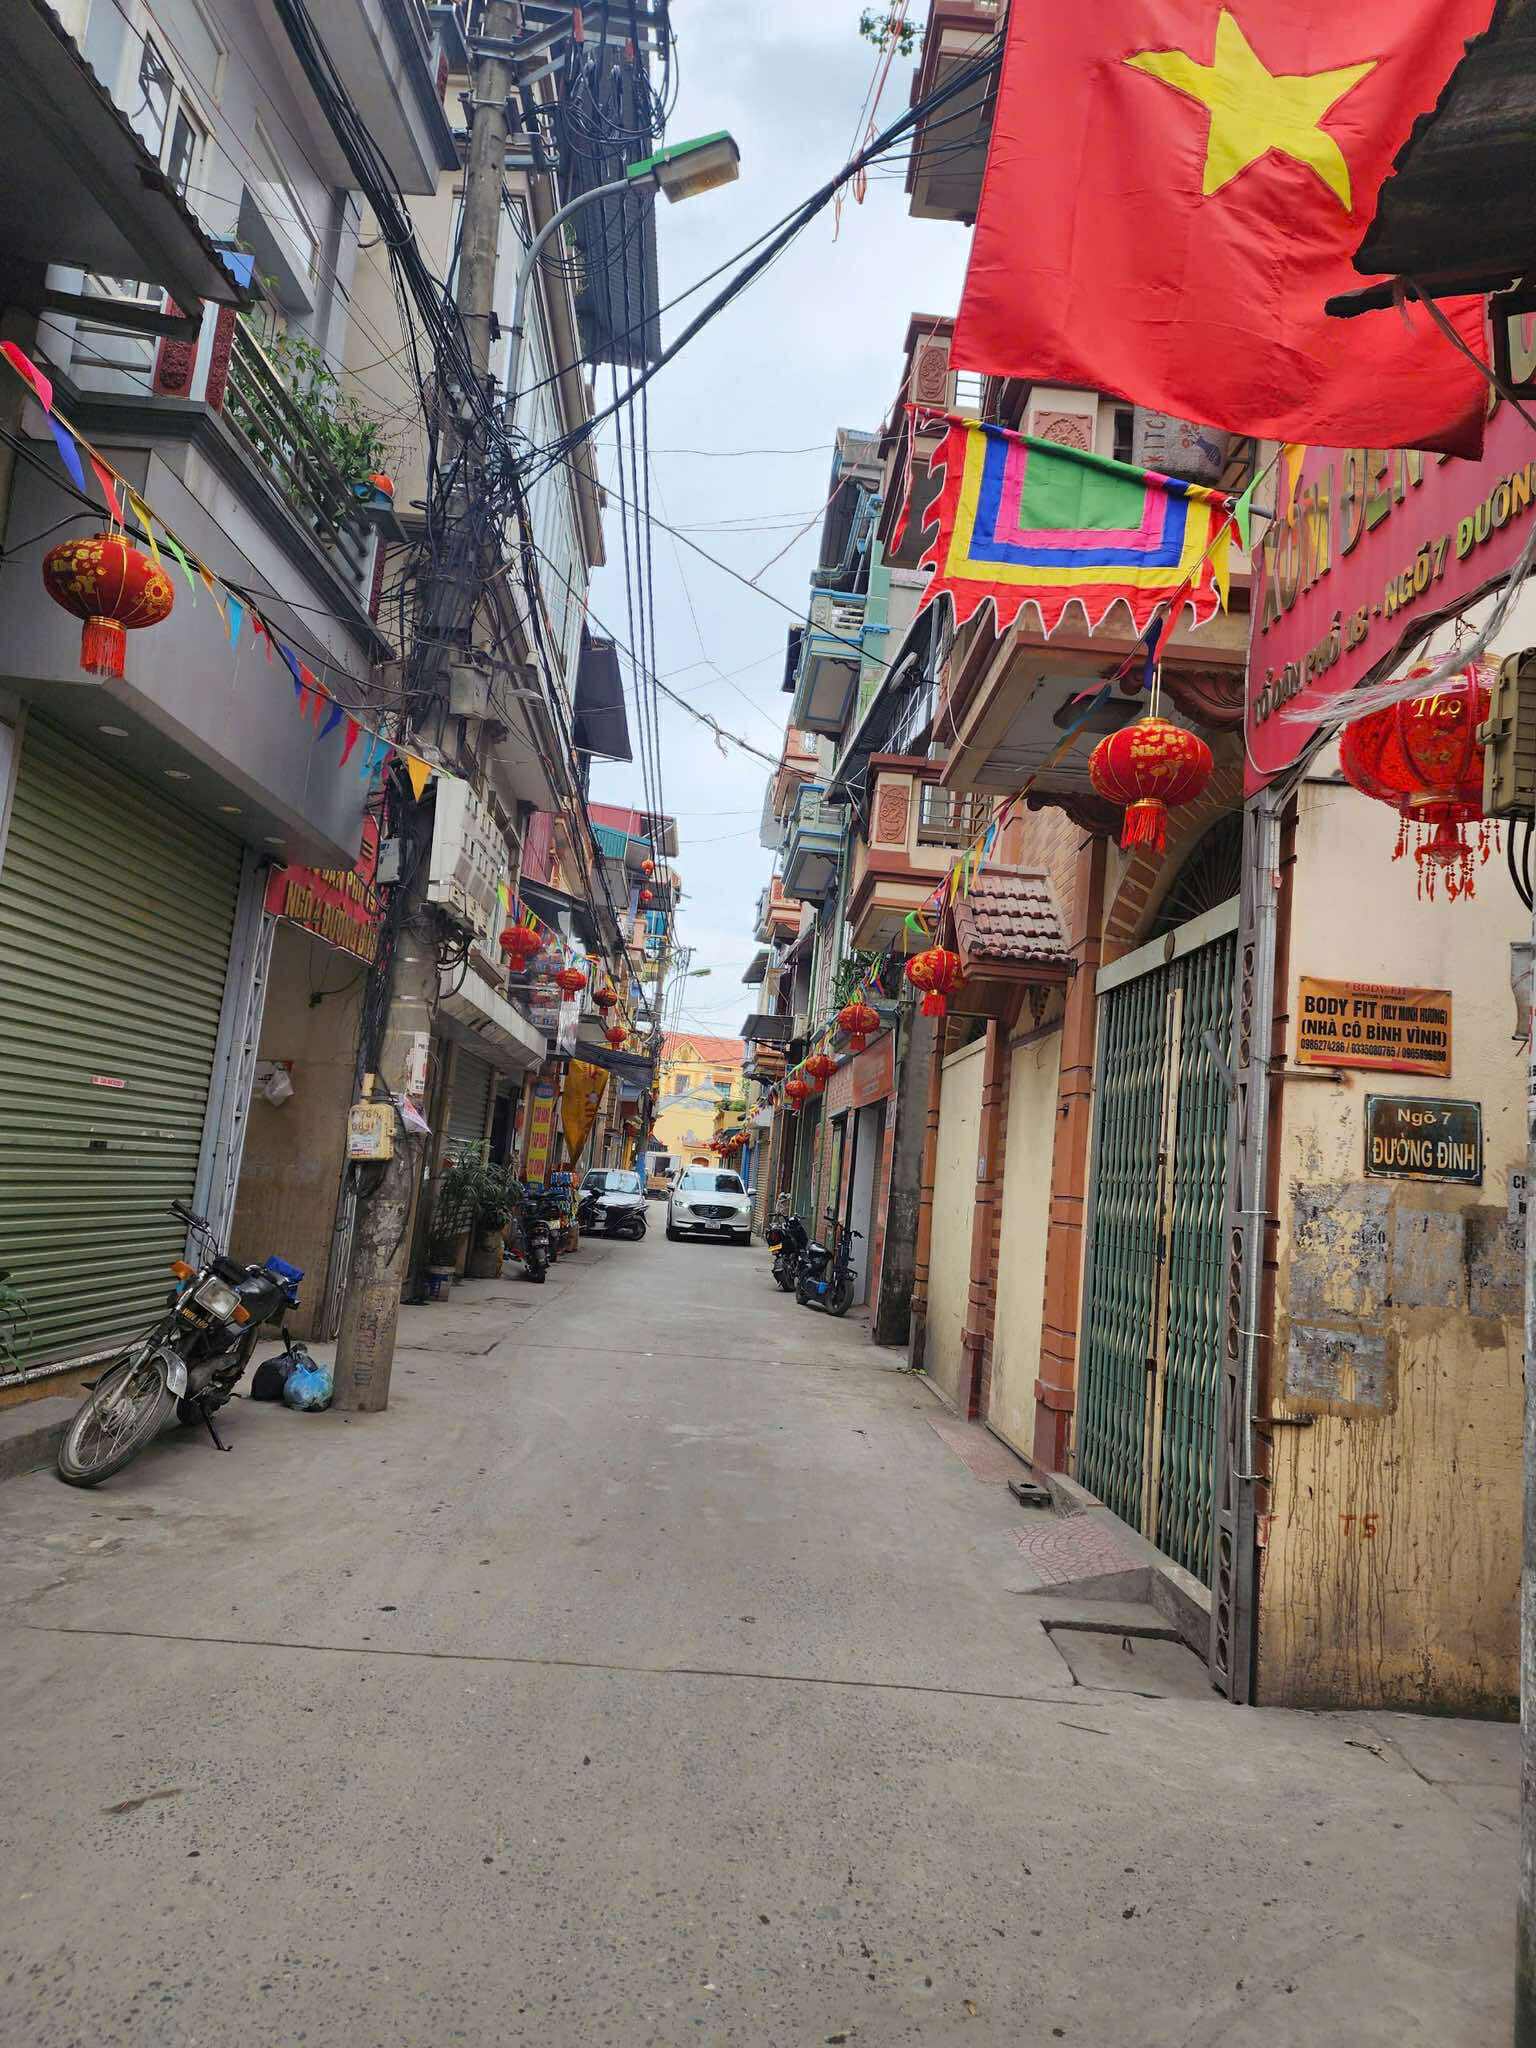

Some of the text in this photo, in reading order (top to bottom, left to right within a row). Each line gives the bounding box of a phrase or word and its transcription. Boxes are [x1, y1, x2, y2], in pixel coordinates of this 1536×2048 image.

[1305, 995, 1348, 1017] BODY
[1353, 1000, 1378, 1019] FIT
[1301, 1018, 1337, 1036] (NHÀ
[1342, 1019, 1362, 1039] CÔ
[1366, 1022, 1401, 1042] BÌNH
[1397, 1108, 1452, 1127] Ngõ 7
[1372, 1132, 1475, 1171] ĐƯỜNG ĐÌNH
